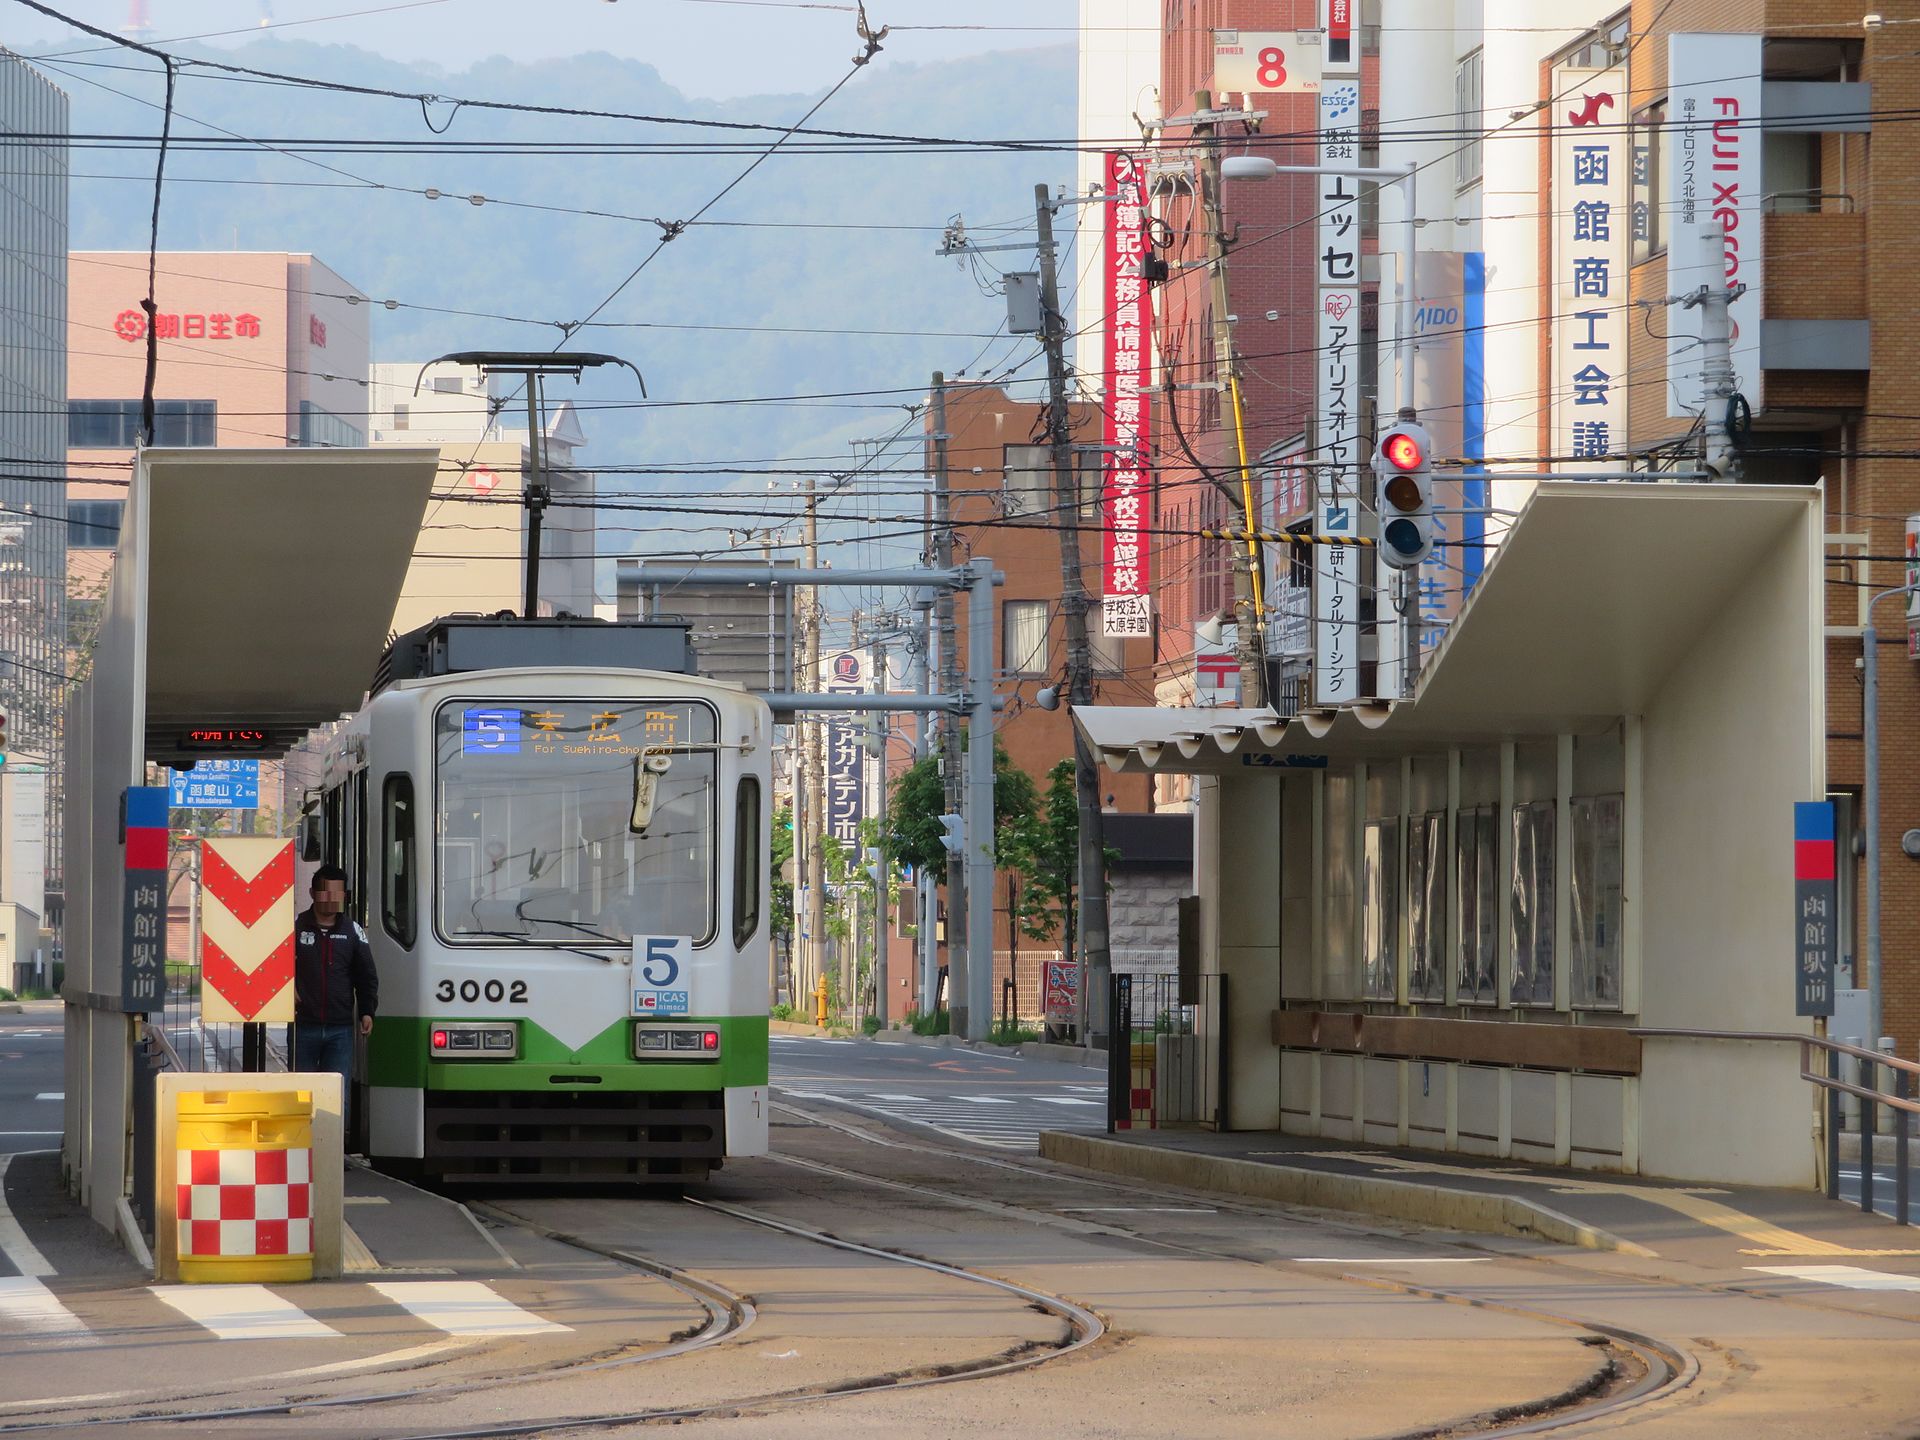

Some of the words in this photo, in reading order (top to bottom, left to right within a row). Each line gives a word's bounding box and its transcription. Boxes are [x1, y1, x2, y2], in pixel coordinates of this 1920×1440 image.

[1257, 47, 1287, 88] 8
[1322, 96, 1348, 106] ESSE
[1712, 97, 1738, 171] FUJI
[1325, 146, 1352, 158] 会社
[1682, 97, 1696, 224] 富士ゼロックス北海道
[1572, 145, 1610, 462] 函館商工会議
[156, 313, 261, 339] 朝日生命
[1104, 600, 1147, 615] 学校法人
[1104, 616, 1147, 633] 大原学園
[478, 713, 506, 749] 5
[535, 745, 555, 754] For
[562, 745, 640, 755] Suehiro-cho
[191, 784, 229, 797] 函館山
[236, 784, 243, 797] 2
[643, 938, 679, 986] 5
[435, 979, 529, 1003] 3002
[659, 992, 686, 1003] ICAS
